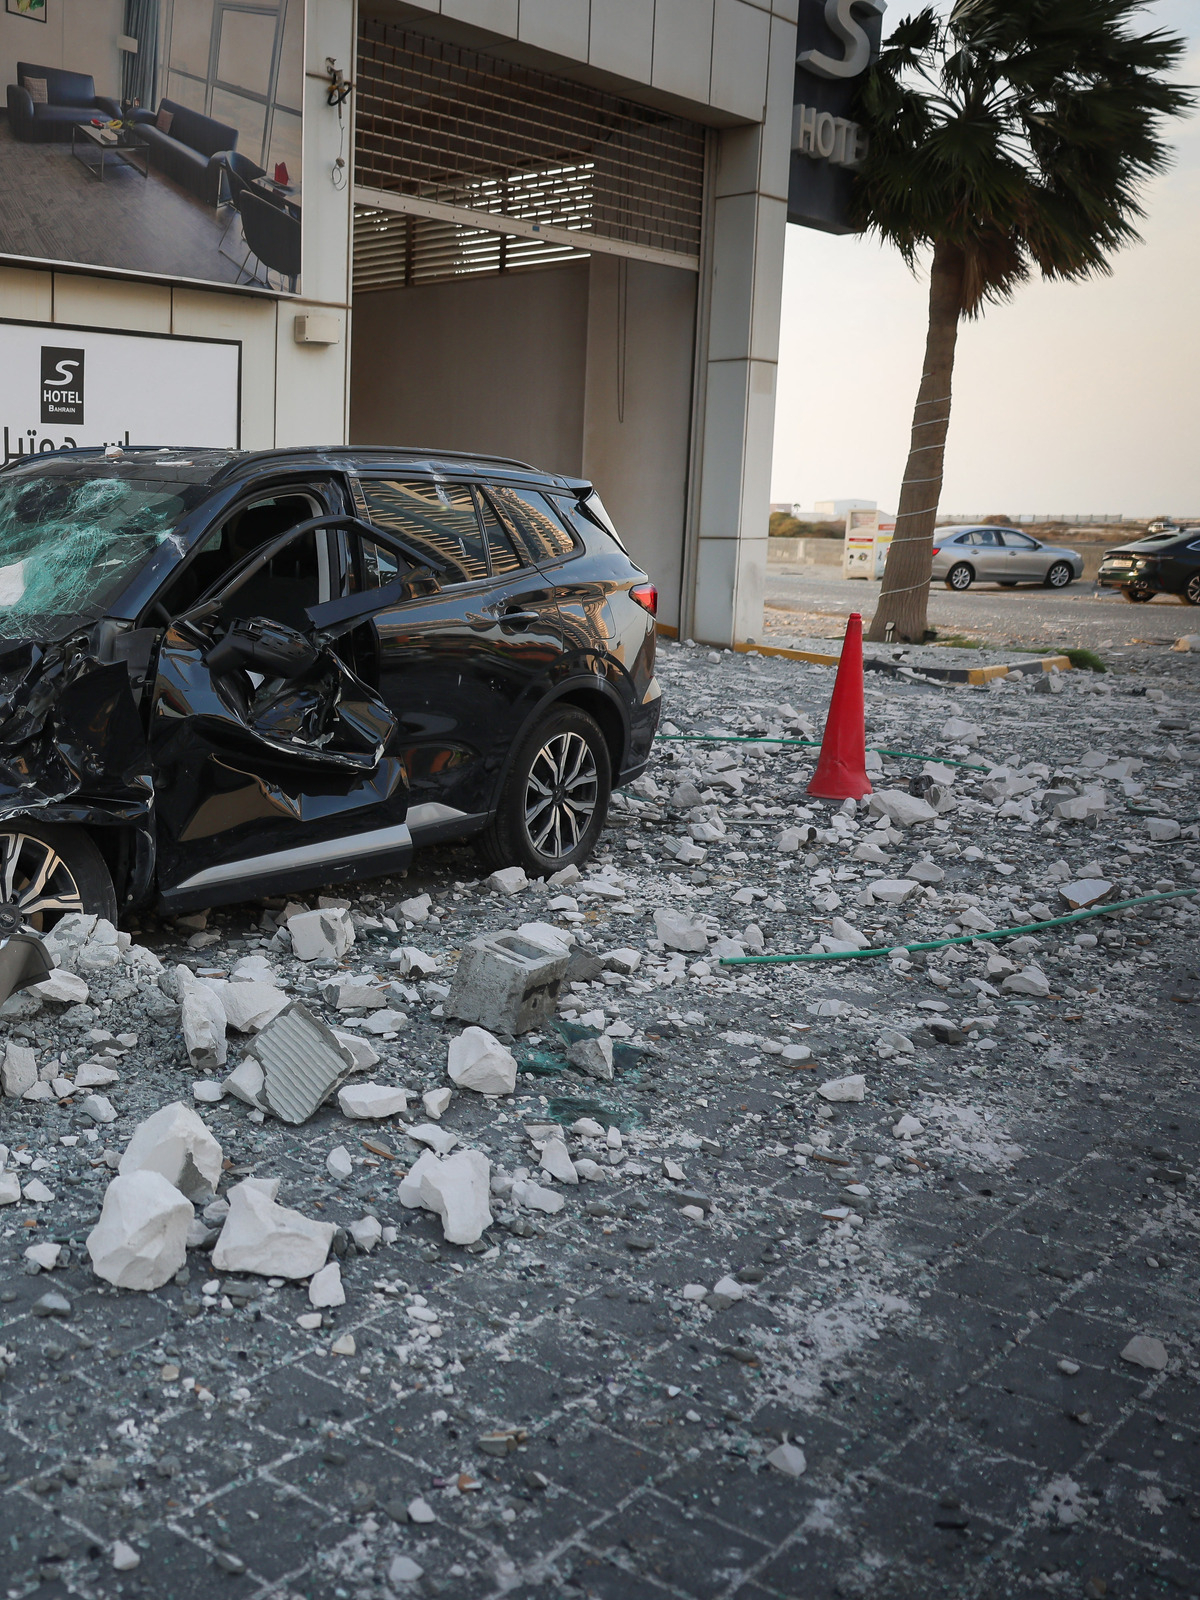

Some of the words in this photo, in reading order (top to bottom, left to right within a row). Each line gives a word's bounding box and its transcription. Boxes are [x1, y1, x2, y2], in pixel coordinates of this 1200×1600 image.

[792, 103, 870, 166] HOTE
[43, 359, 80, 386] S
[43, 389, 83, 404] HOTEL
